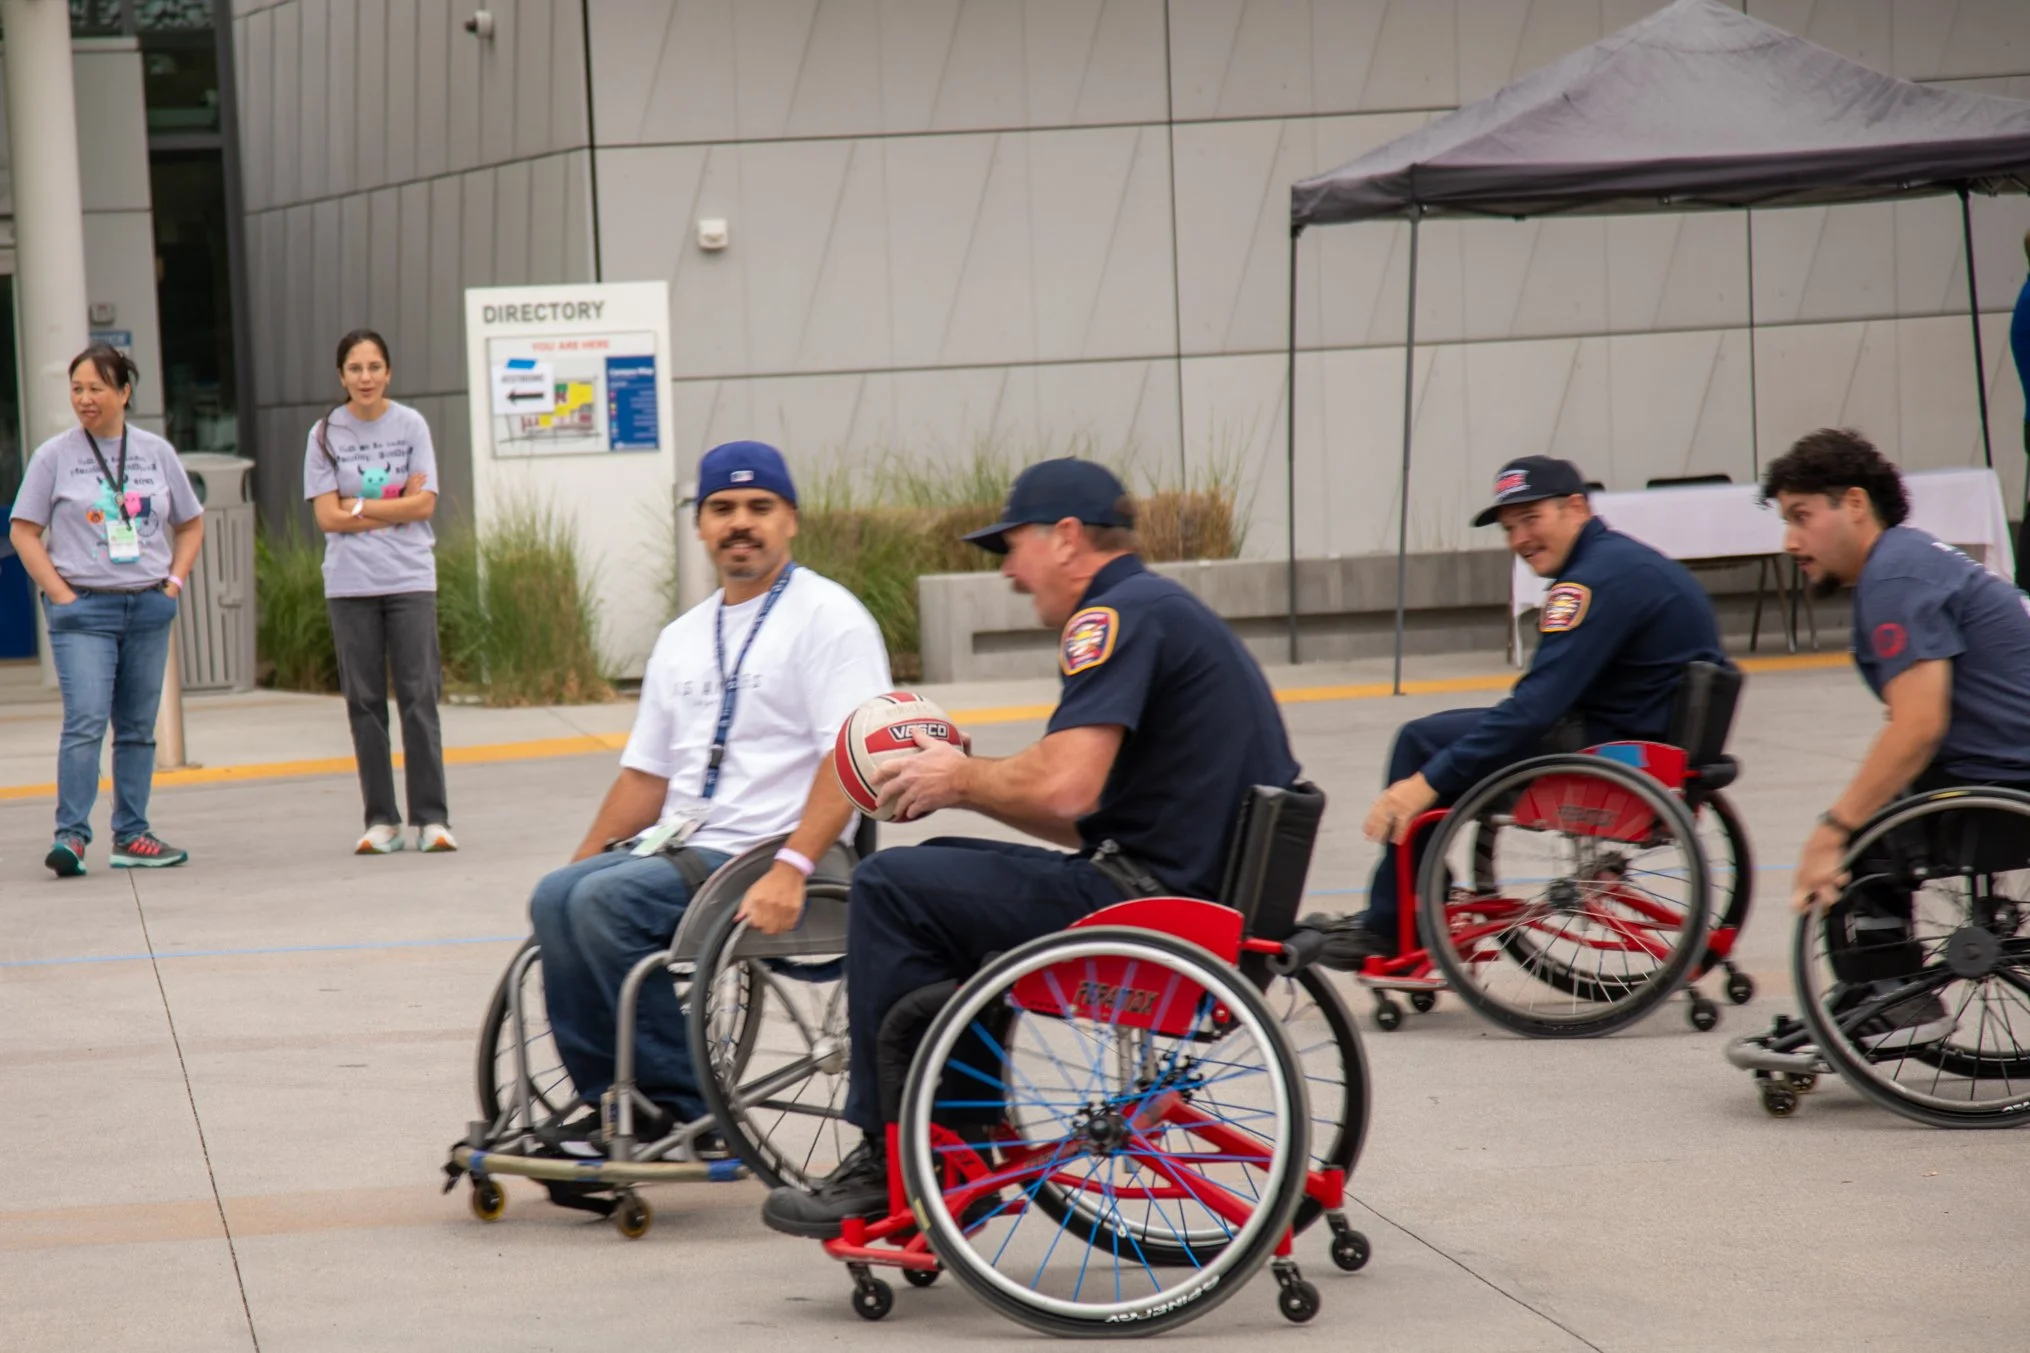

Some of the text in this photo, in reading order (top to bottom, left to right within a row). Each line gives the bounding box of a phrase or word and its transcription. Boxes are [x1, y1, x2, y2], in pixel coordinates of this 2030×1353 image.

[482, 301, 604, 324] DIRECTORY
[532, 339, 609, 352] YOU ARE HERE
